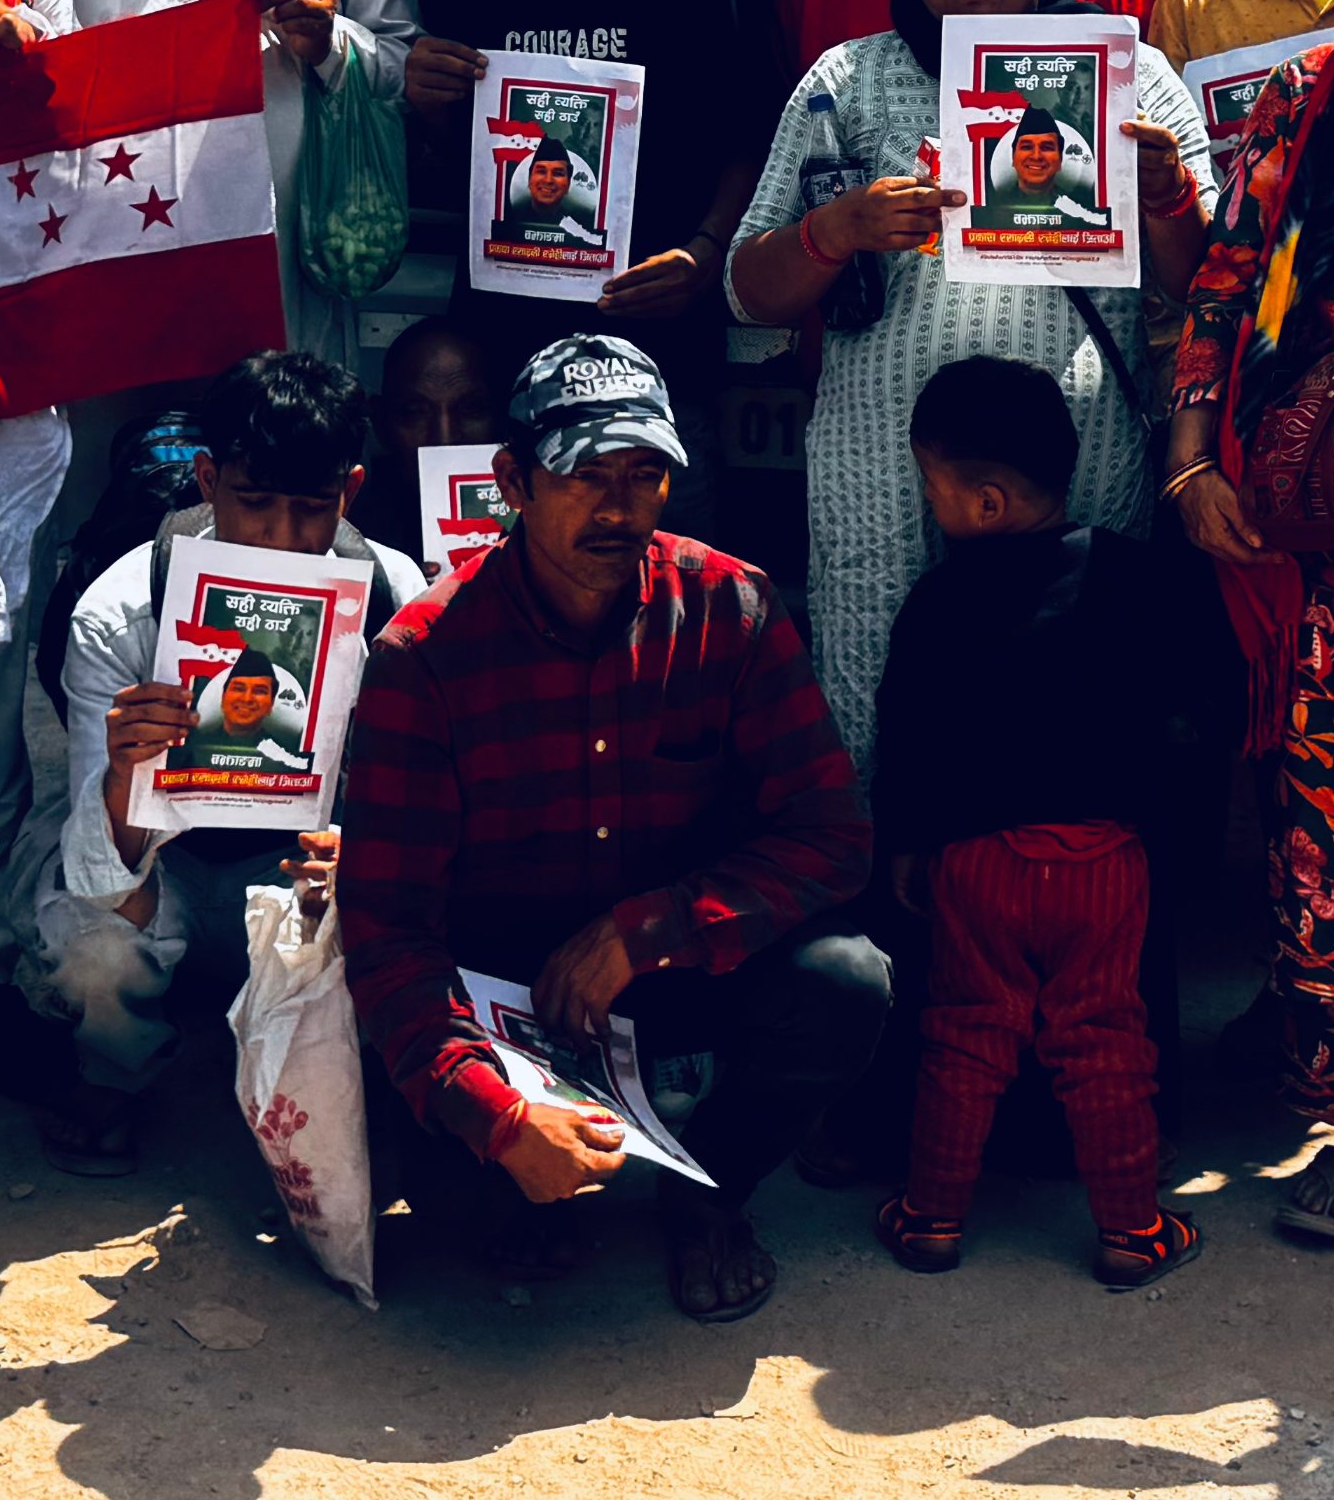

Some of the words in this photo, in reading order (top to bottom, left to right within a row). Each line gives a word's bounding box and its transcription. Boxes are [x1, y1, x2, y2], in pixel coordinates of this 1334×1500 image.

[505, 28, 627, 59] COURAGE
[1004, 58, 1031, 75] सही
[1036, 58, 1077, 73] व्यक्ति
[1014, 77, 1038, 91] सही
[526, 93, 550, 108] सही
[534, 110, 556, 123] सही
[563, 358, 637, 384] ROYAL
[226, 593, 254, 614] सही
[260, 599, 303, 616] व्यक्ति
[234, 615, 261, 632] सही
